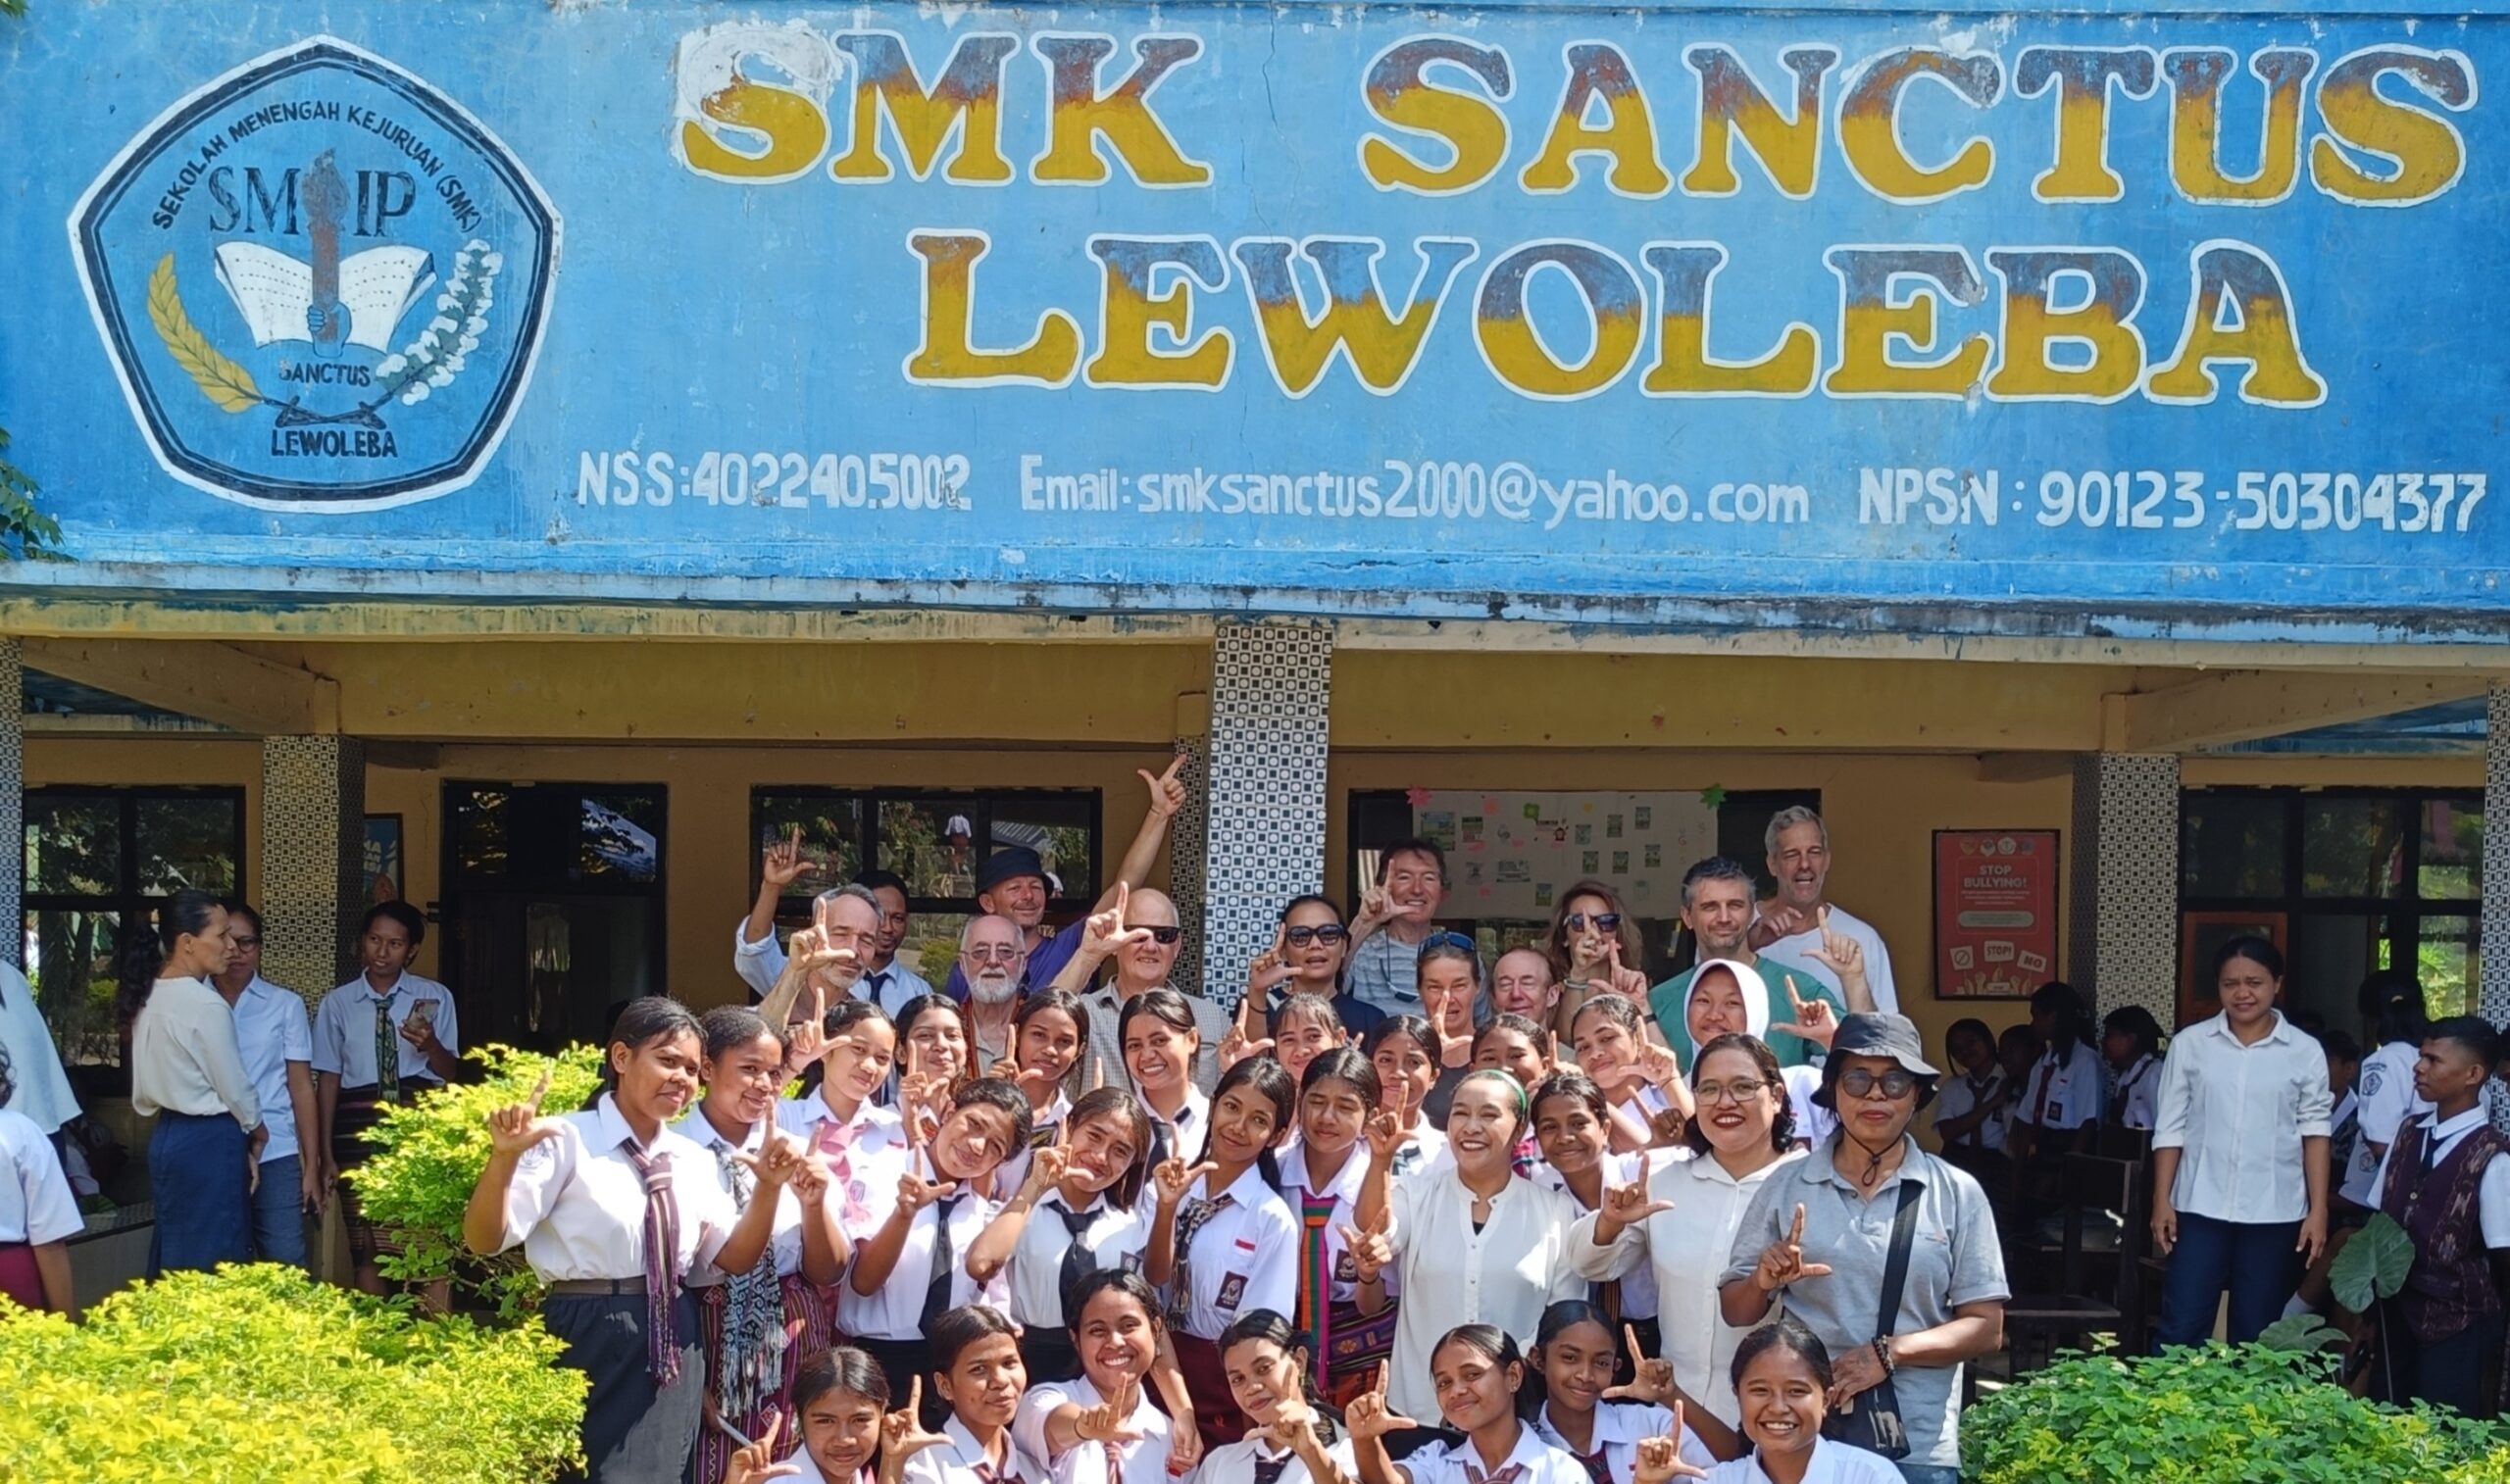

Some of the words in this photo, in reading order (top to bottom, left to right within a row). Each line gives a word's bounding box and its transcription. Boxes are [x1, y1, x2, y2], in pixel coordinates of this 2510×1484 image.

[679, 30, 1214, 187] SMK
[1357, 33, 2479, 208] SANCTUS
[152, 134, 228, 230] SEKOLAH
[227, 100, 340, 143] MENENGAH
[347, 105, 445, 178] KEJURUAN
[435, 174, 482, 233] (SMK)
[903, 228, 2329, 409] LEWOLEBA
[278, 358, 371, 387] SANCTUS
[271, 429, 398, 458] LEWOLEBA
[1963, 877, 2028, 889] BULLYING!
[1979, 864, 2012, 876] STOP
[1986, 945, 2012, 956] STOP!
[2023, 955, 2043, 968] NO
